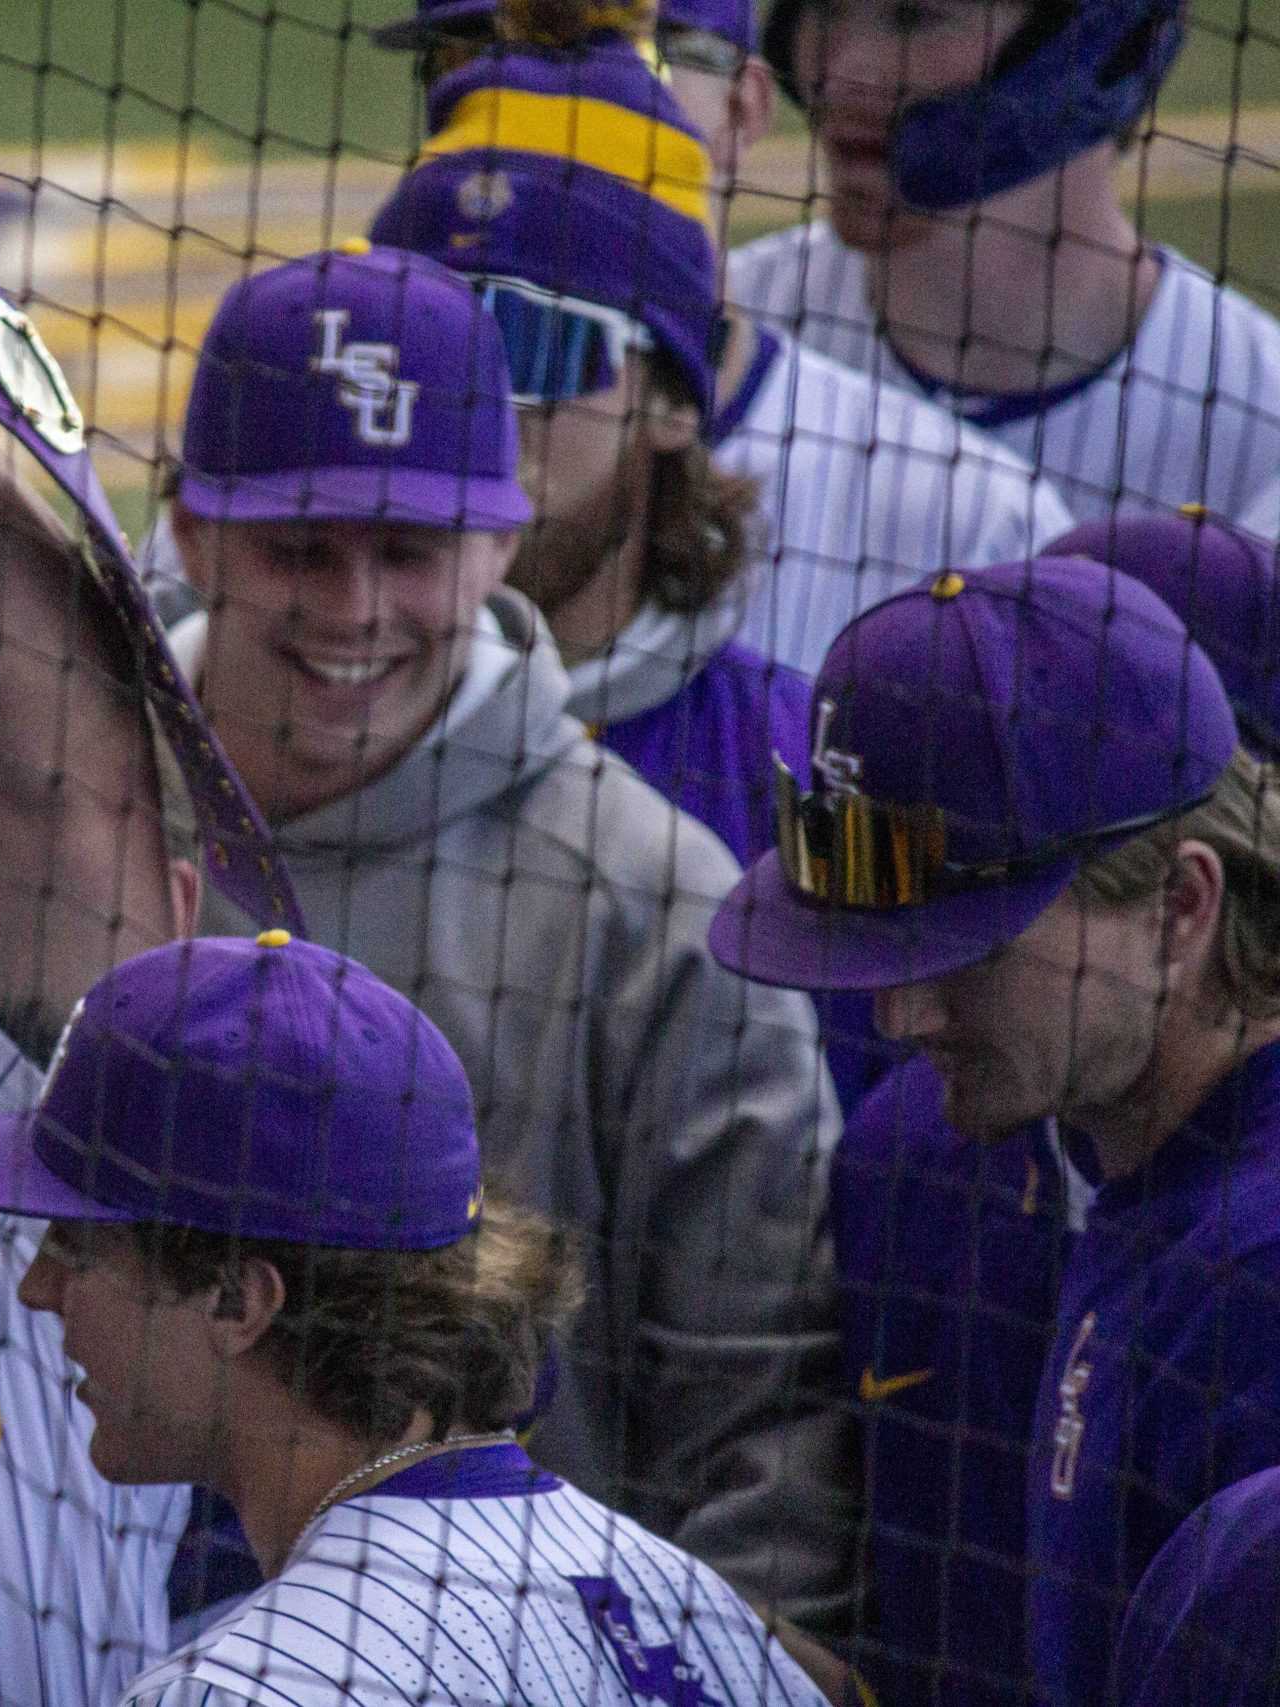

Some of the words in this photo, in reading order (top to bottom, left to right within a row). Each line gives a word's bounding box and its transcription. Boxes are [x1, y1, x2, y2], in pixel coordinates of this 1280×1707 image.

[310, 309, 421, 446] LSU
[812, 698, 861, 814] LS
[1050, 1311, 1097, 1500] LSU
